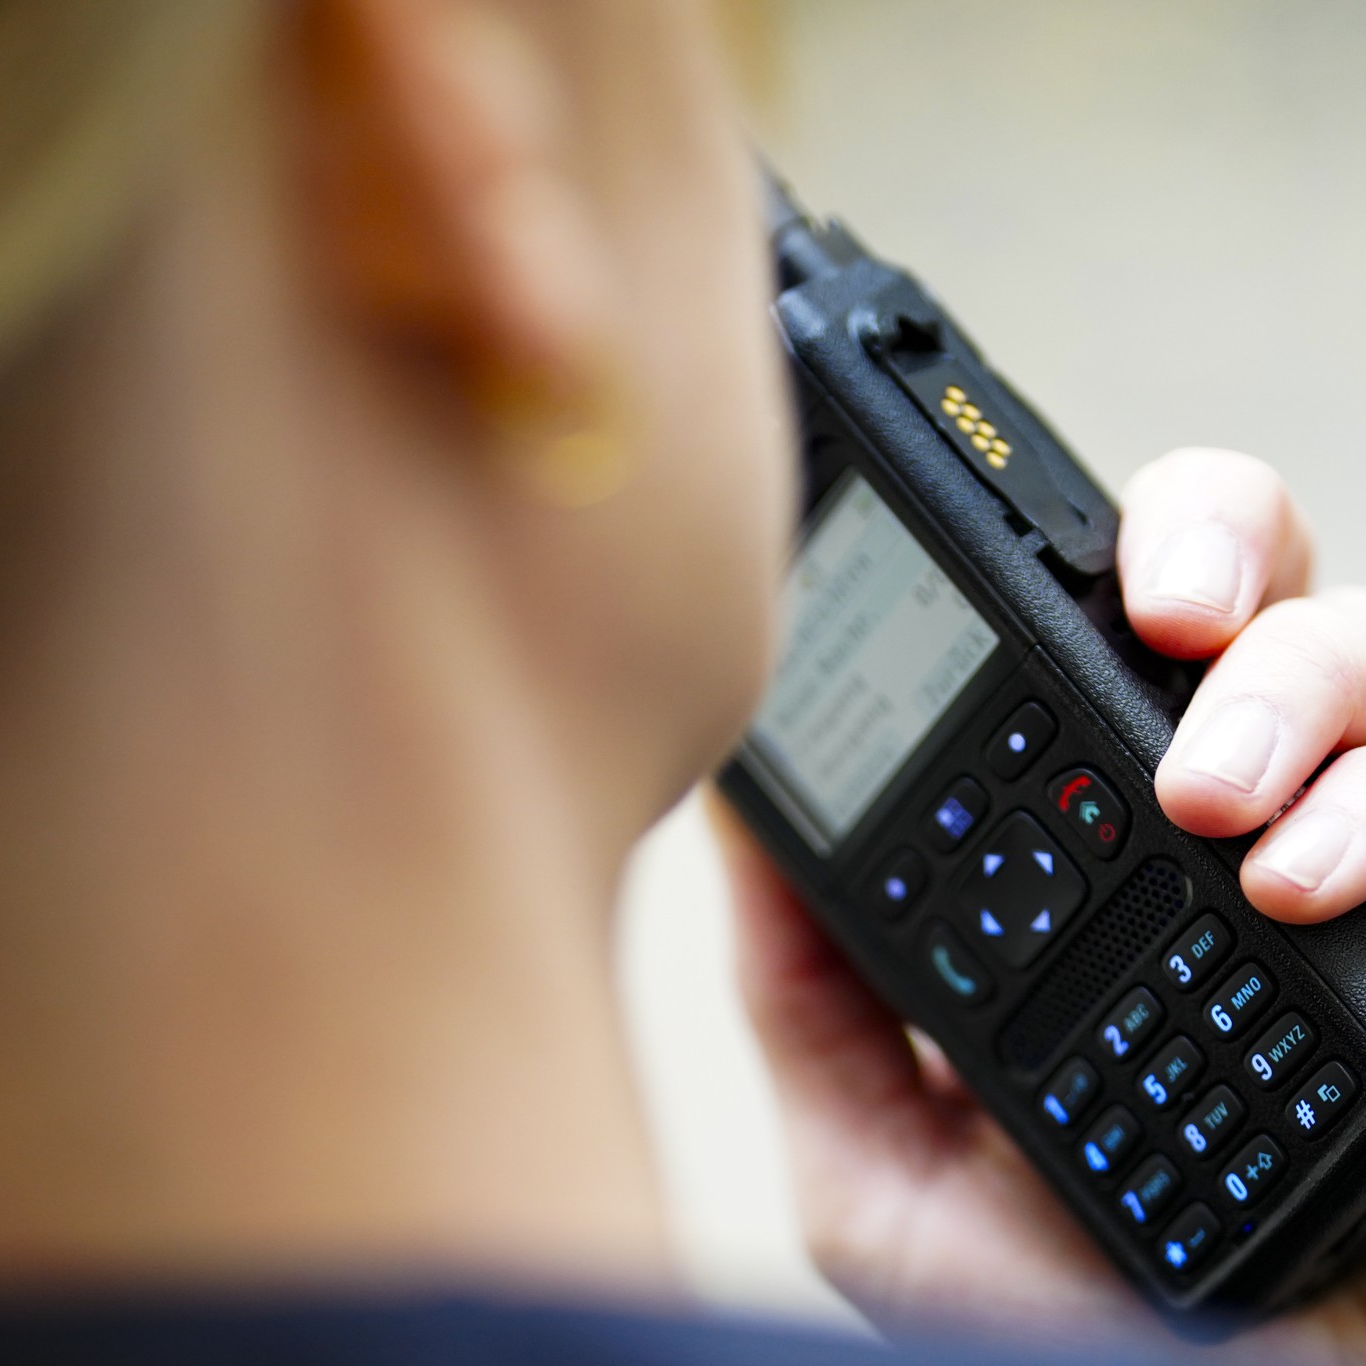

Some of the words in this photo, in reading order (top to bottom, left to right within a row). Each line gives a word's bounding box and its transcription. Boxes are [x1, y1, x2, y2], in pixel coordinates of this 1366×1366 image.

[1169, 954, 1193, 983] 3
[1190, 930, 1215, 960] DEF
[1210, 1004, 1234, 1033] 6
[1230, 976, 1262, 1011] MNO
[1103, 1024, 1130, 1057] 2
[1124, 1003, 1150, 1033] ABC
[1250, 1053, 1273, 1081] 9
[1267, 1024, 1306, 1063] WXYZ
[1141, 1073, 1168, 1105] 5
[1165, 1056, 1189, 1084] JKL
[1043, 1092, 1070, 1125] 1
[1184, 1123, 1207, 1152] 8
[1203, 1102, 1228, 1129] TUV
[1295, 1098, 1316, 1130] #
[1224, 1171, 1249, 1202] 0
